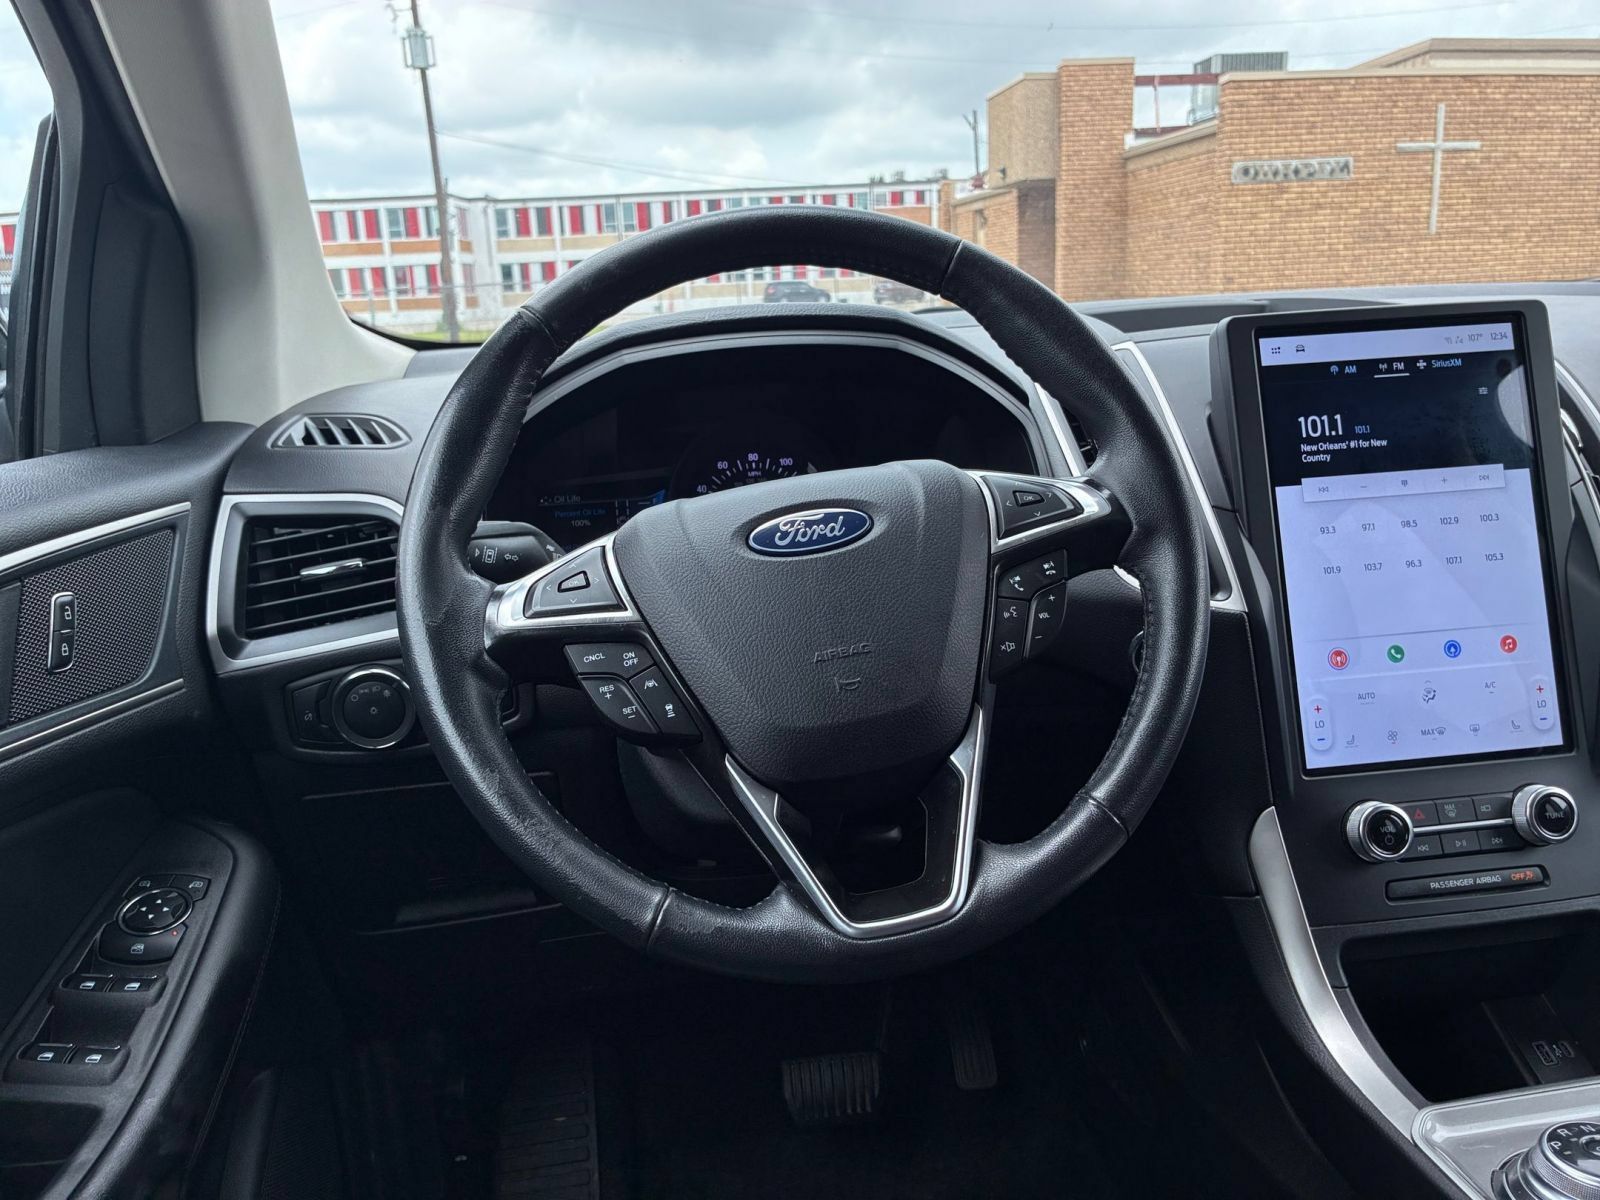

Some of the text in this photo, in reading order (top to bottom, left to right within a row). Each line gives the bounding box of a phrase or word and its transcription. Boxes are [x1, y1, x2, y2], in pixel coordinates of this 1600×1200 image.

[1490, 332, 1508, 340] 12:34
[1393, 362, 1404, 371] FM
[1432, 358, 1462, 368] SiriusXM
[1344, 366, 1356, 374] AM
[1298, 414, 1370, 438] 101.1 101.1
[1301, 439, 1388, 452] New Orleans' #1 for New
[748, 453, 758, 461] 80
[1302, 454, 1331, 462] Country
[717, 460, 728, 470] 60
[779, 458, 793, 466] 100
[696, 484, 707, 493] 40
[1320, 513, 1500, 535] 93.3 97.1 98.5 102.9 100.3
[775, 513, 845, 546] Ford
[1323, 552, 1504, 575] 101.9 103.7 96.3 107.1 105.3
[584, 653, 606, 663] CNCL
[623, 658, 639, 667] OFF
[599, 685, 614, 693] RES
[1485, 681, 1496, 689] A/C
[1357, 692, 1376, 701] AUTO
[1537, 700, 1546, 708] LO
[622, 706, 637, 715] SET
[1421, 728, 1435, 736] MAX
[1430, 872, 1526, 890] PASSENGER AIRBAG OFF
[1557, 1128, 1572, 1137] R
[1551, 1141, 1562, 1150] P
